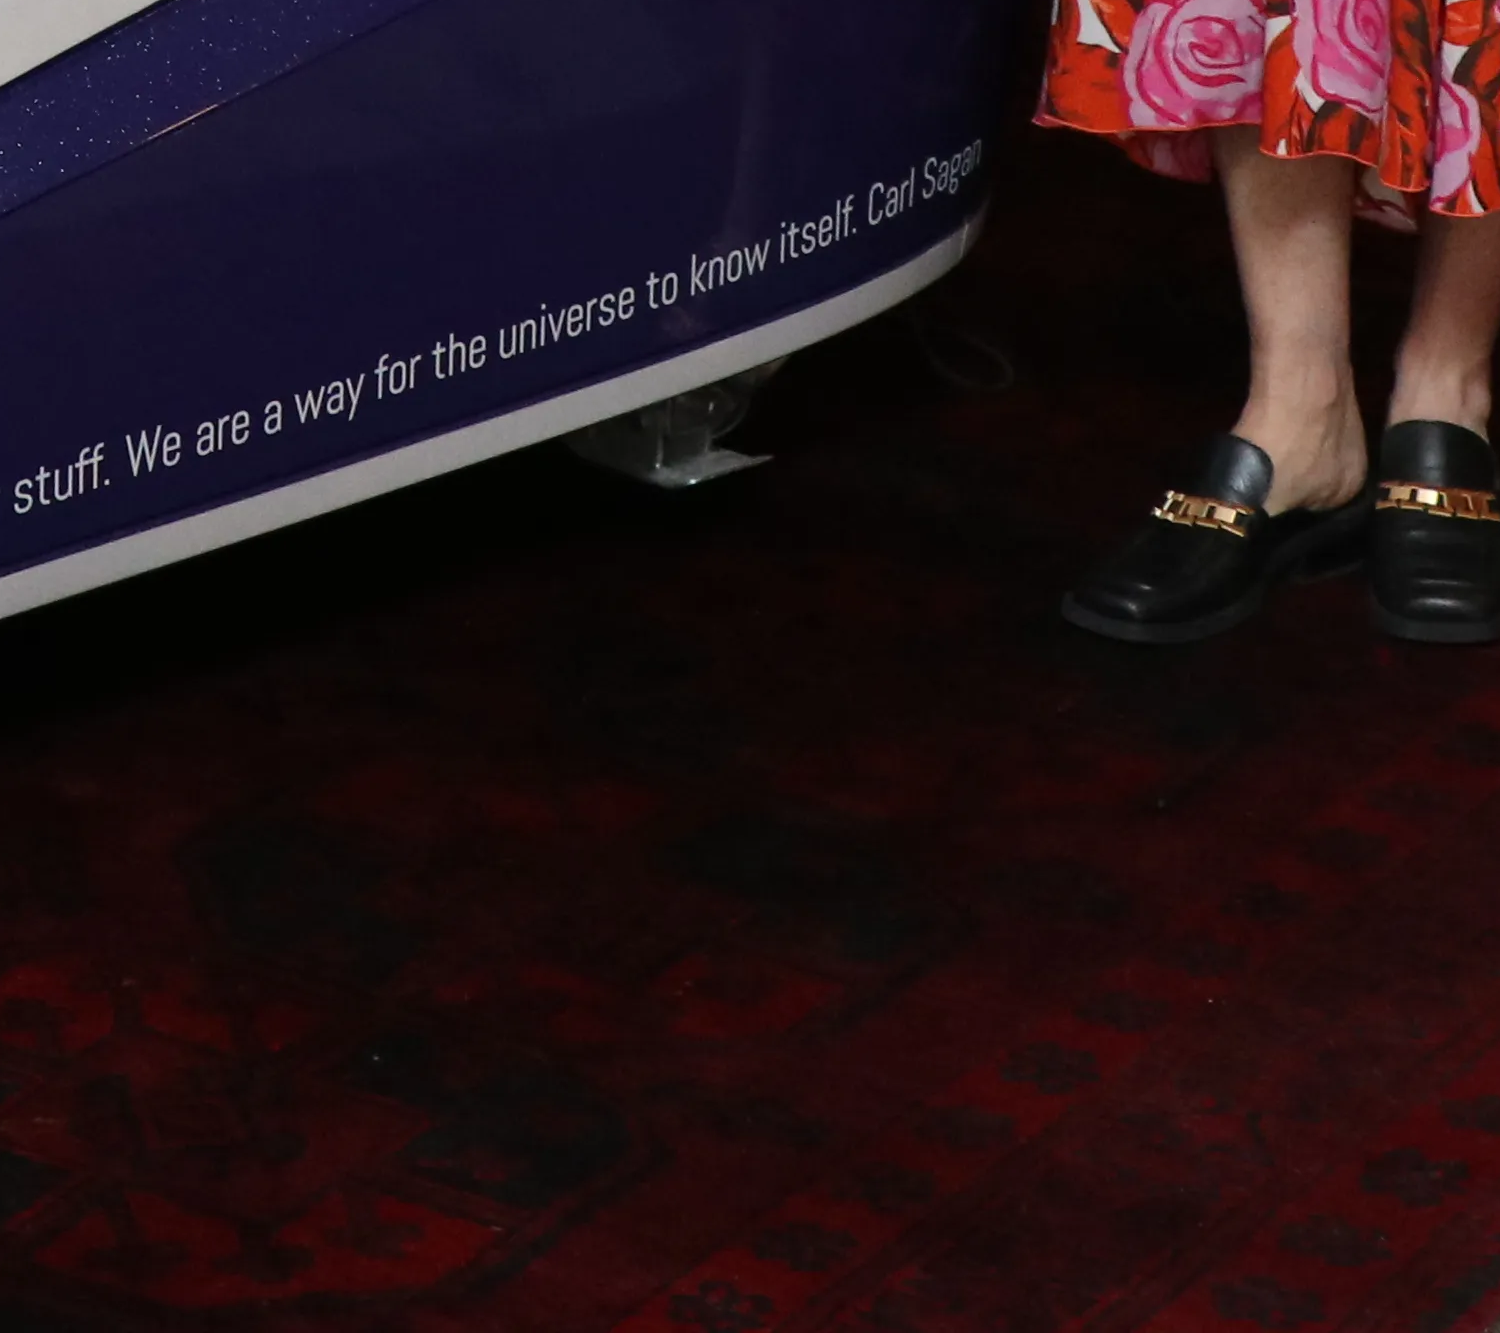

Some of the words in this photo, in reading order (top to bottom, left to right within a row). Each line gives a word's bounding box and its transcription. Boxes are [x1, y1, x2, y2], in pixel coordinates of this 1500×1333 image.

[13, 441, 111, 514] stuff.
[125, 424, 182, 477] We
[196, 410, 250, 456] are
[263, 400, 283, 435] a
[294, 372, 366, 424] way
[373, 353, 422, 400] for
[431, 332, 487, 380] the
[498, 286, 635, 359] universe
[645, 271, 679, 310] to
[690, 238, 771, 297] know
[779, 194, 858, 264] itself.
[867, 167, 916, 226] Carl
[922, 137, 983, 199] Sagan
